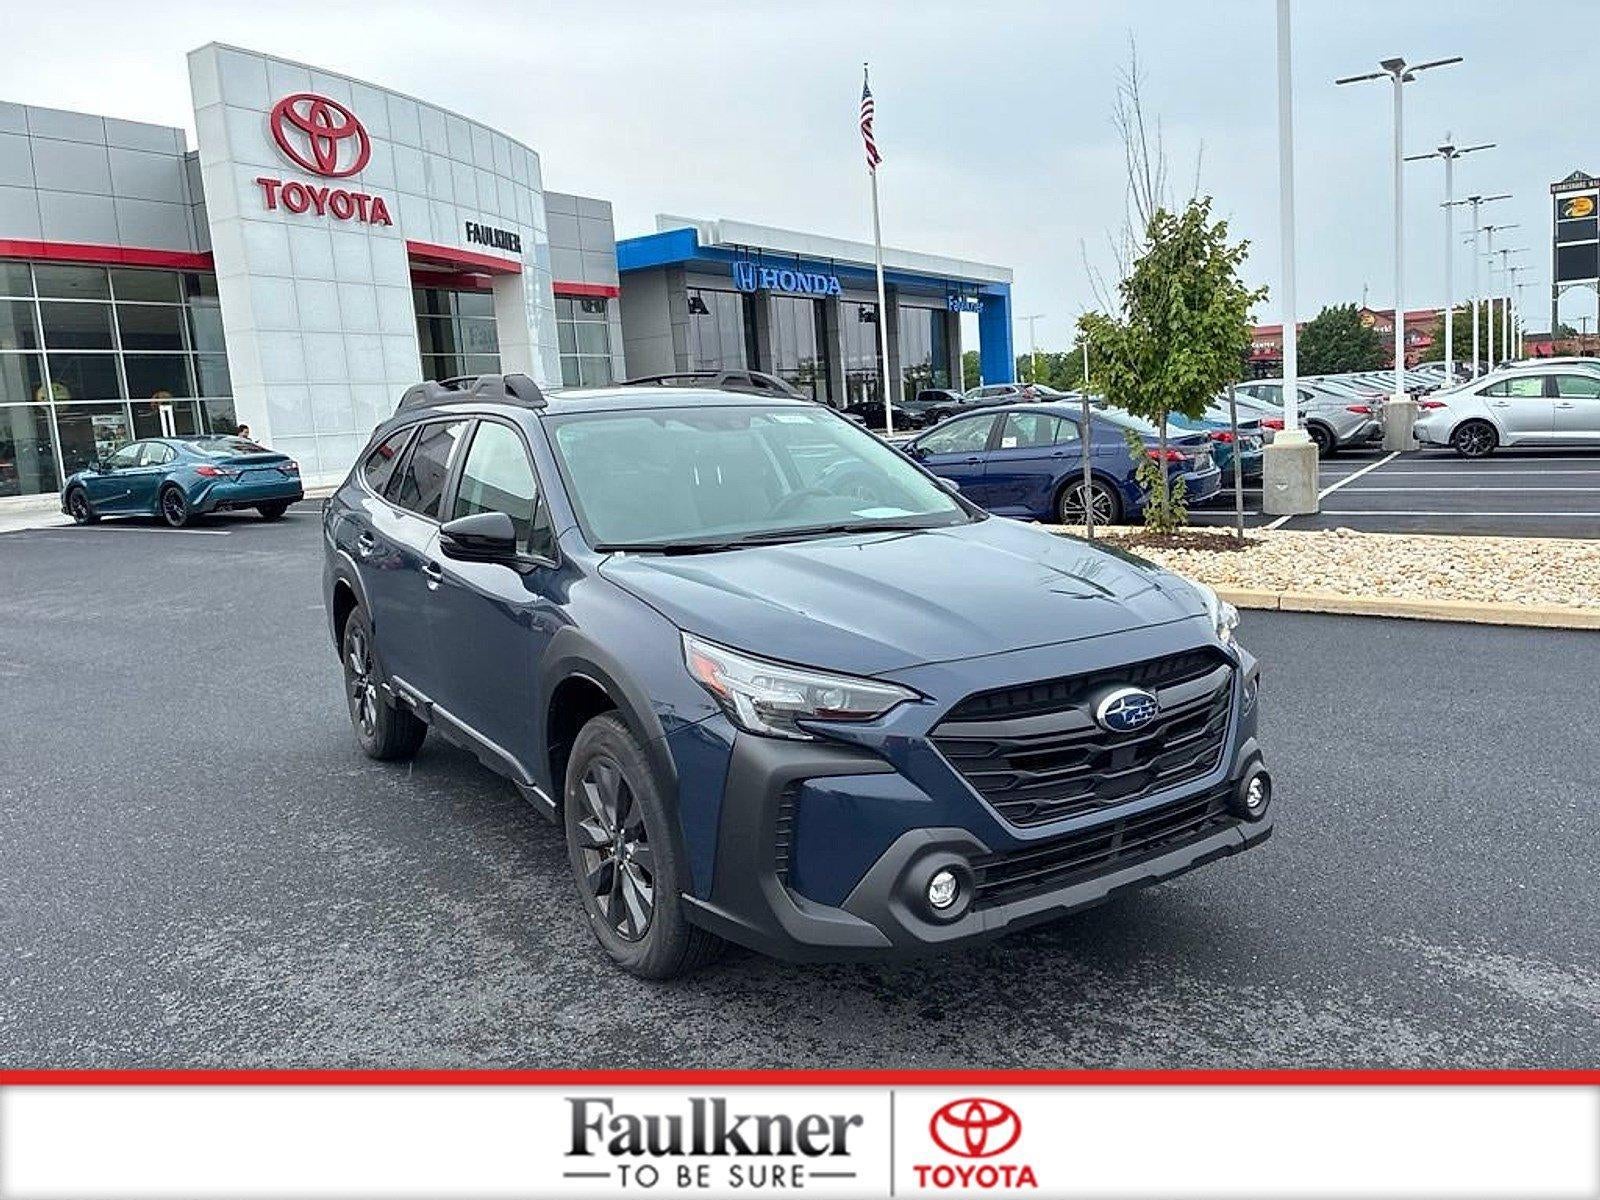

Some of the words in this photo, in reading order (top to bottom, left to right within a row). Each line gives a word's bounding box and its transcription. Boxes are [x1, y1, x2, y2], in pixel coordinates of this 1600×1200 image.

[257, 177, 392, 225] TOYOTA
[465, 221, 522, 253] FAULKNER
[760, 268, 842, 295] HONDA
